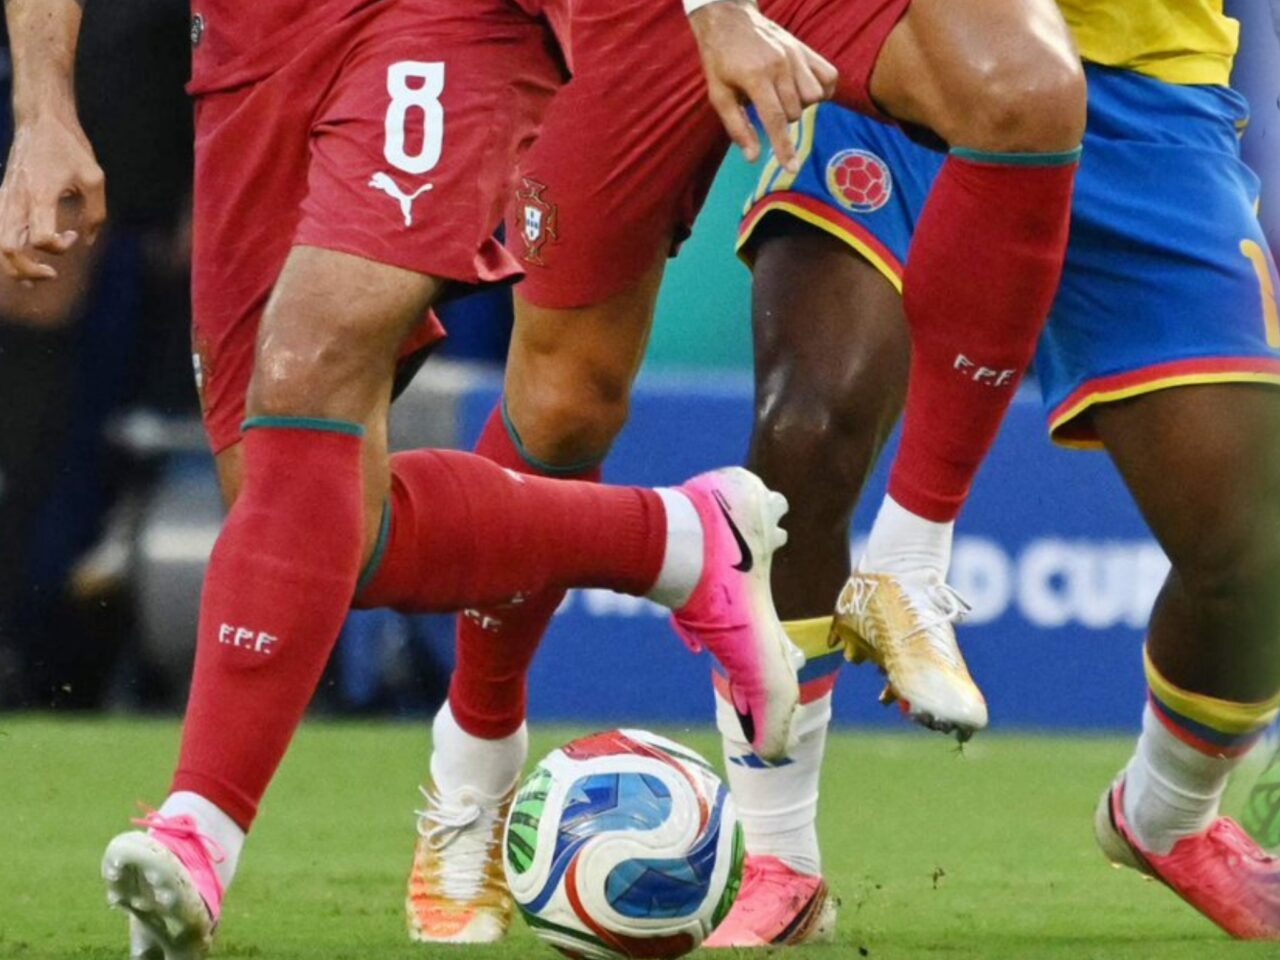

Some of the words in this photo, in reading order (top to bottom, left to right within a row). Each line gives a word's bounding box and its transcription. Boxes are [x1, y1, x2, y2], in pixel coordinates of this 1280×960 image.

[383, 60, 446, 175] 8
[953, 353, 1017, 387] F.P.F.
[836, 576, 879, 615] CR7
[218, 622, 279, 656] F.P.F.
